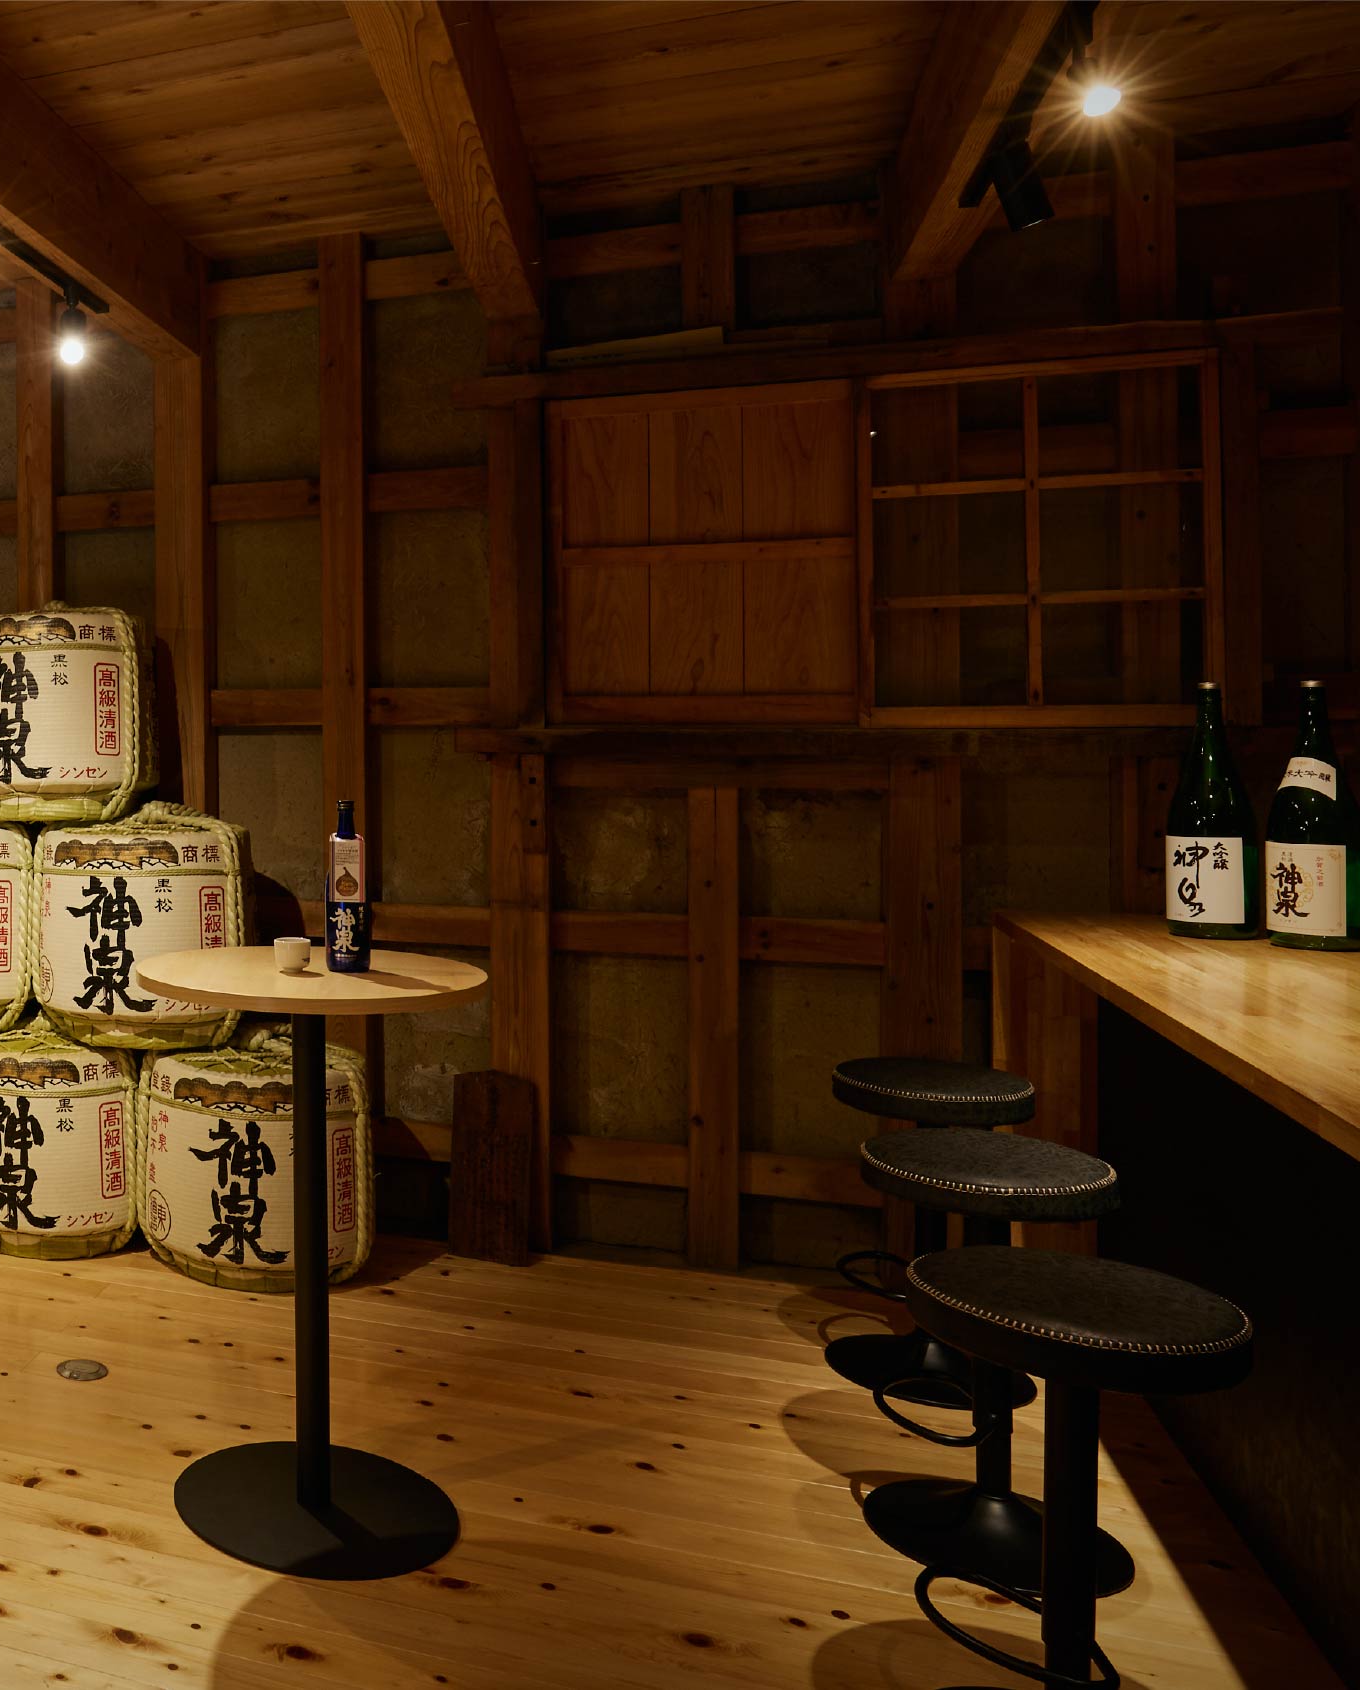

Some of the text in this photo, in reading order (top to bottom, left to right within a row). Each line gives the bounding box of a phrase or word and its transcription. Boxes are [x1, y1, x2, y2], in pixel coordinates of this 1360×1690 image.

[78, 624, 117, 642] 商標
[50, 653, 69, 686] 黒松
[59, 766, 108, 780] シンセン
[182, 844, 221, 864] 商標
[1212, 842, 1229, 870] 大吟醸
[154, 878, 173, 913] 黒松
[1270, 862, 1310, 918] 神泉
[66, 876, 158, 1015] 神泉
[329, 906, 360, 953] 神泉
[83, 1061, 121, 1081] 商標
[56, 1099, 74, 1132] 黒松
[189, 1118, 290, 1264] 神泉
[67, 1211, 114, 1227] シンセン
